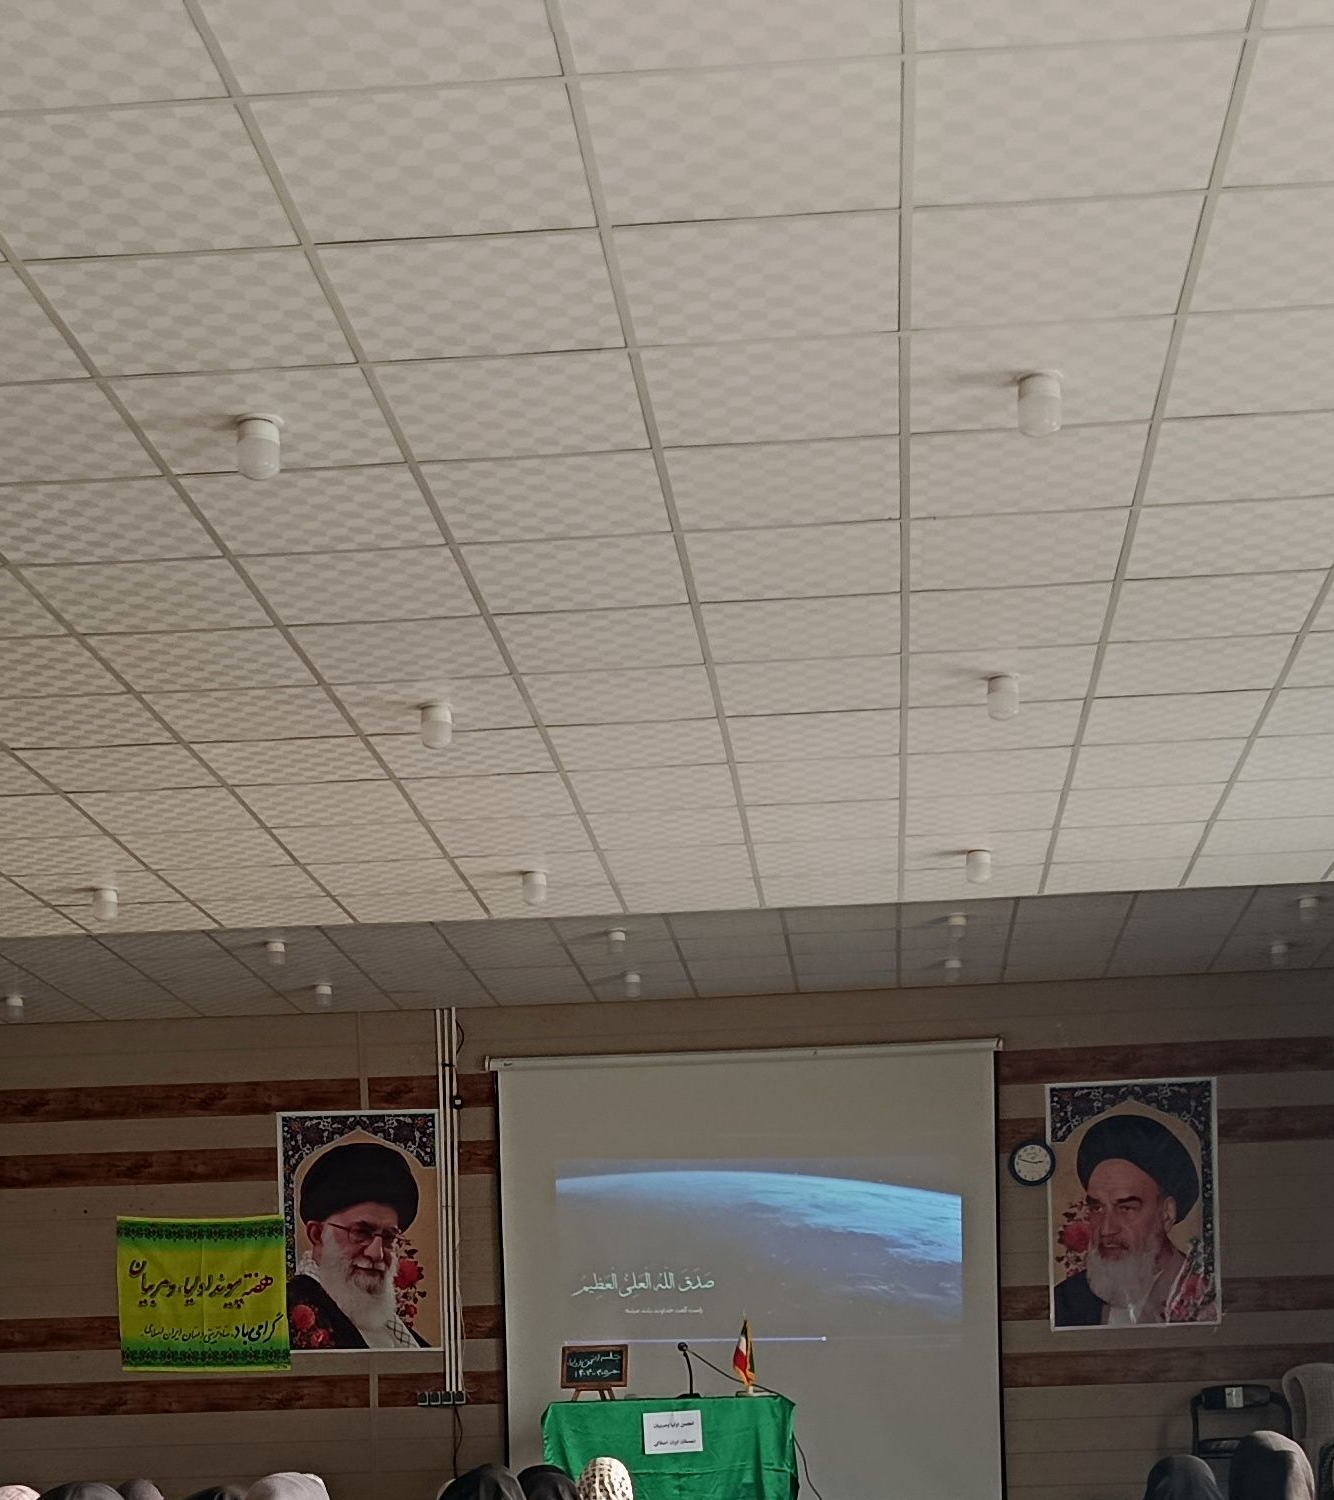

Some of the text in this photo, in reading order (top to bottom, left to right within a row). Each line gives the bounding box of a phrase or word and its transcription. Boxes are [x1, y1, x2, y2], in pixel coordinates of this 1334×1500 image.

[209, 1273, 244, 1309] پیوند
[242, 1272, 274, 1297] هفته
[234, 1312, 284, 1345] گرامی باد
